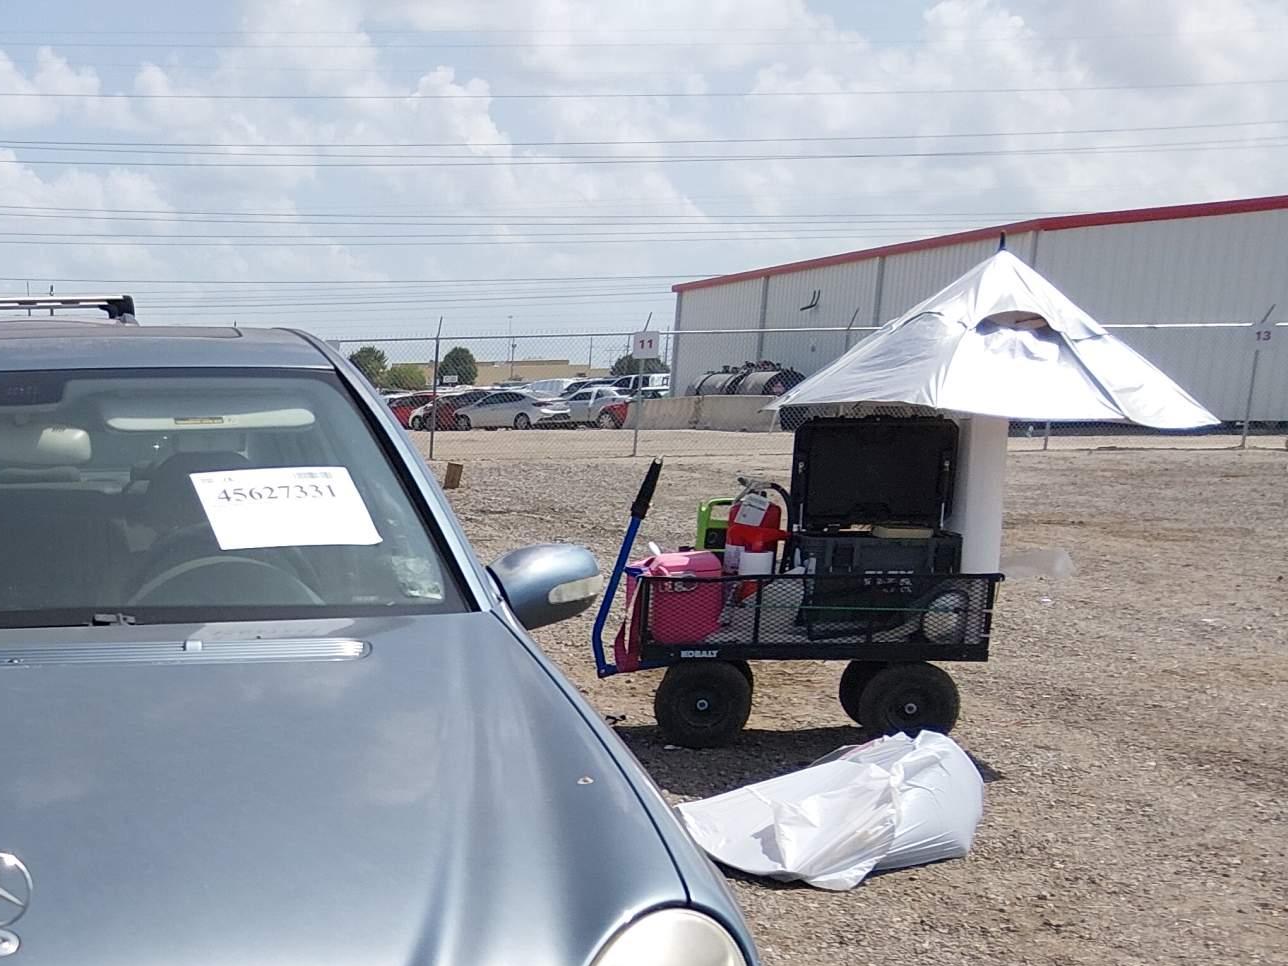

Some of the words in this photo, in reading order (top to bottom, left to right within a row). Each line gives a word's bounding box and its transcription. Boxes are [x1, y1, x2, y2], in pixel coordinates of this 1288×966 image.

[1255, 330, 1272, 341] 13
[639, 339, 653, 349] 11
[217, 484, 337, 502] 45627331
[680, 650, 718, 658] KOBALT
